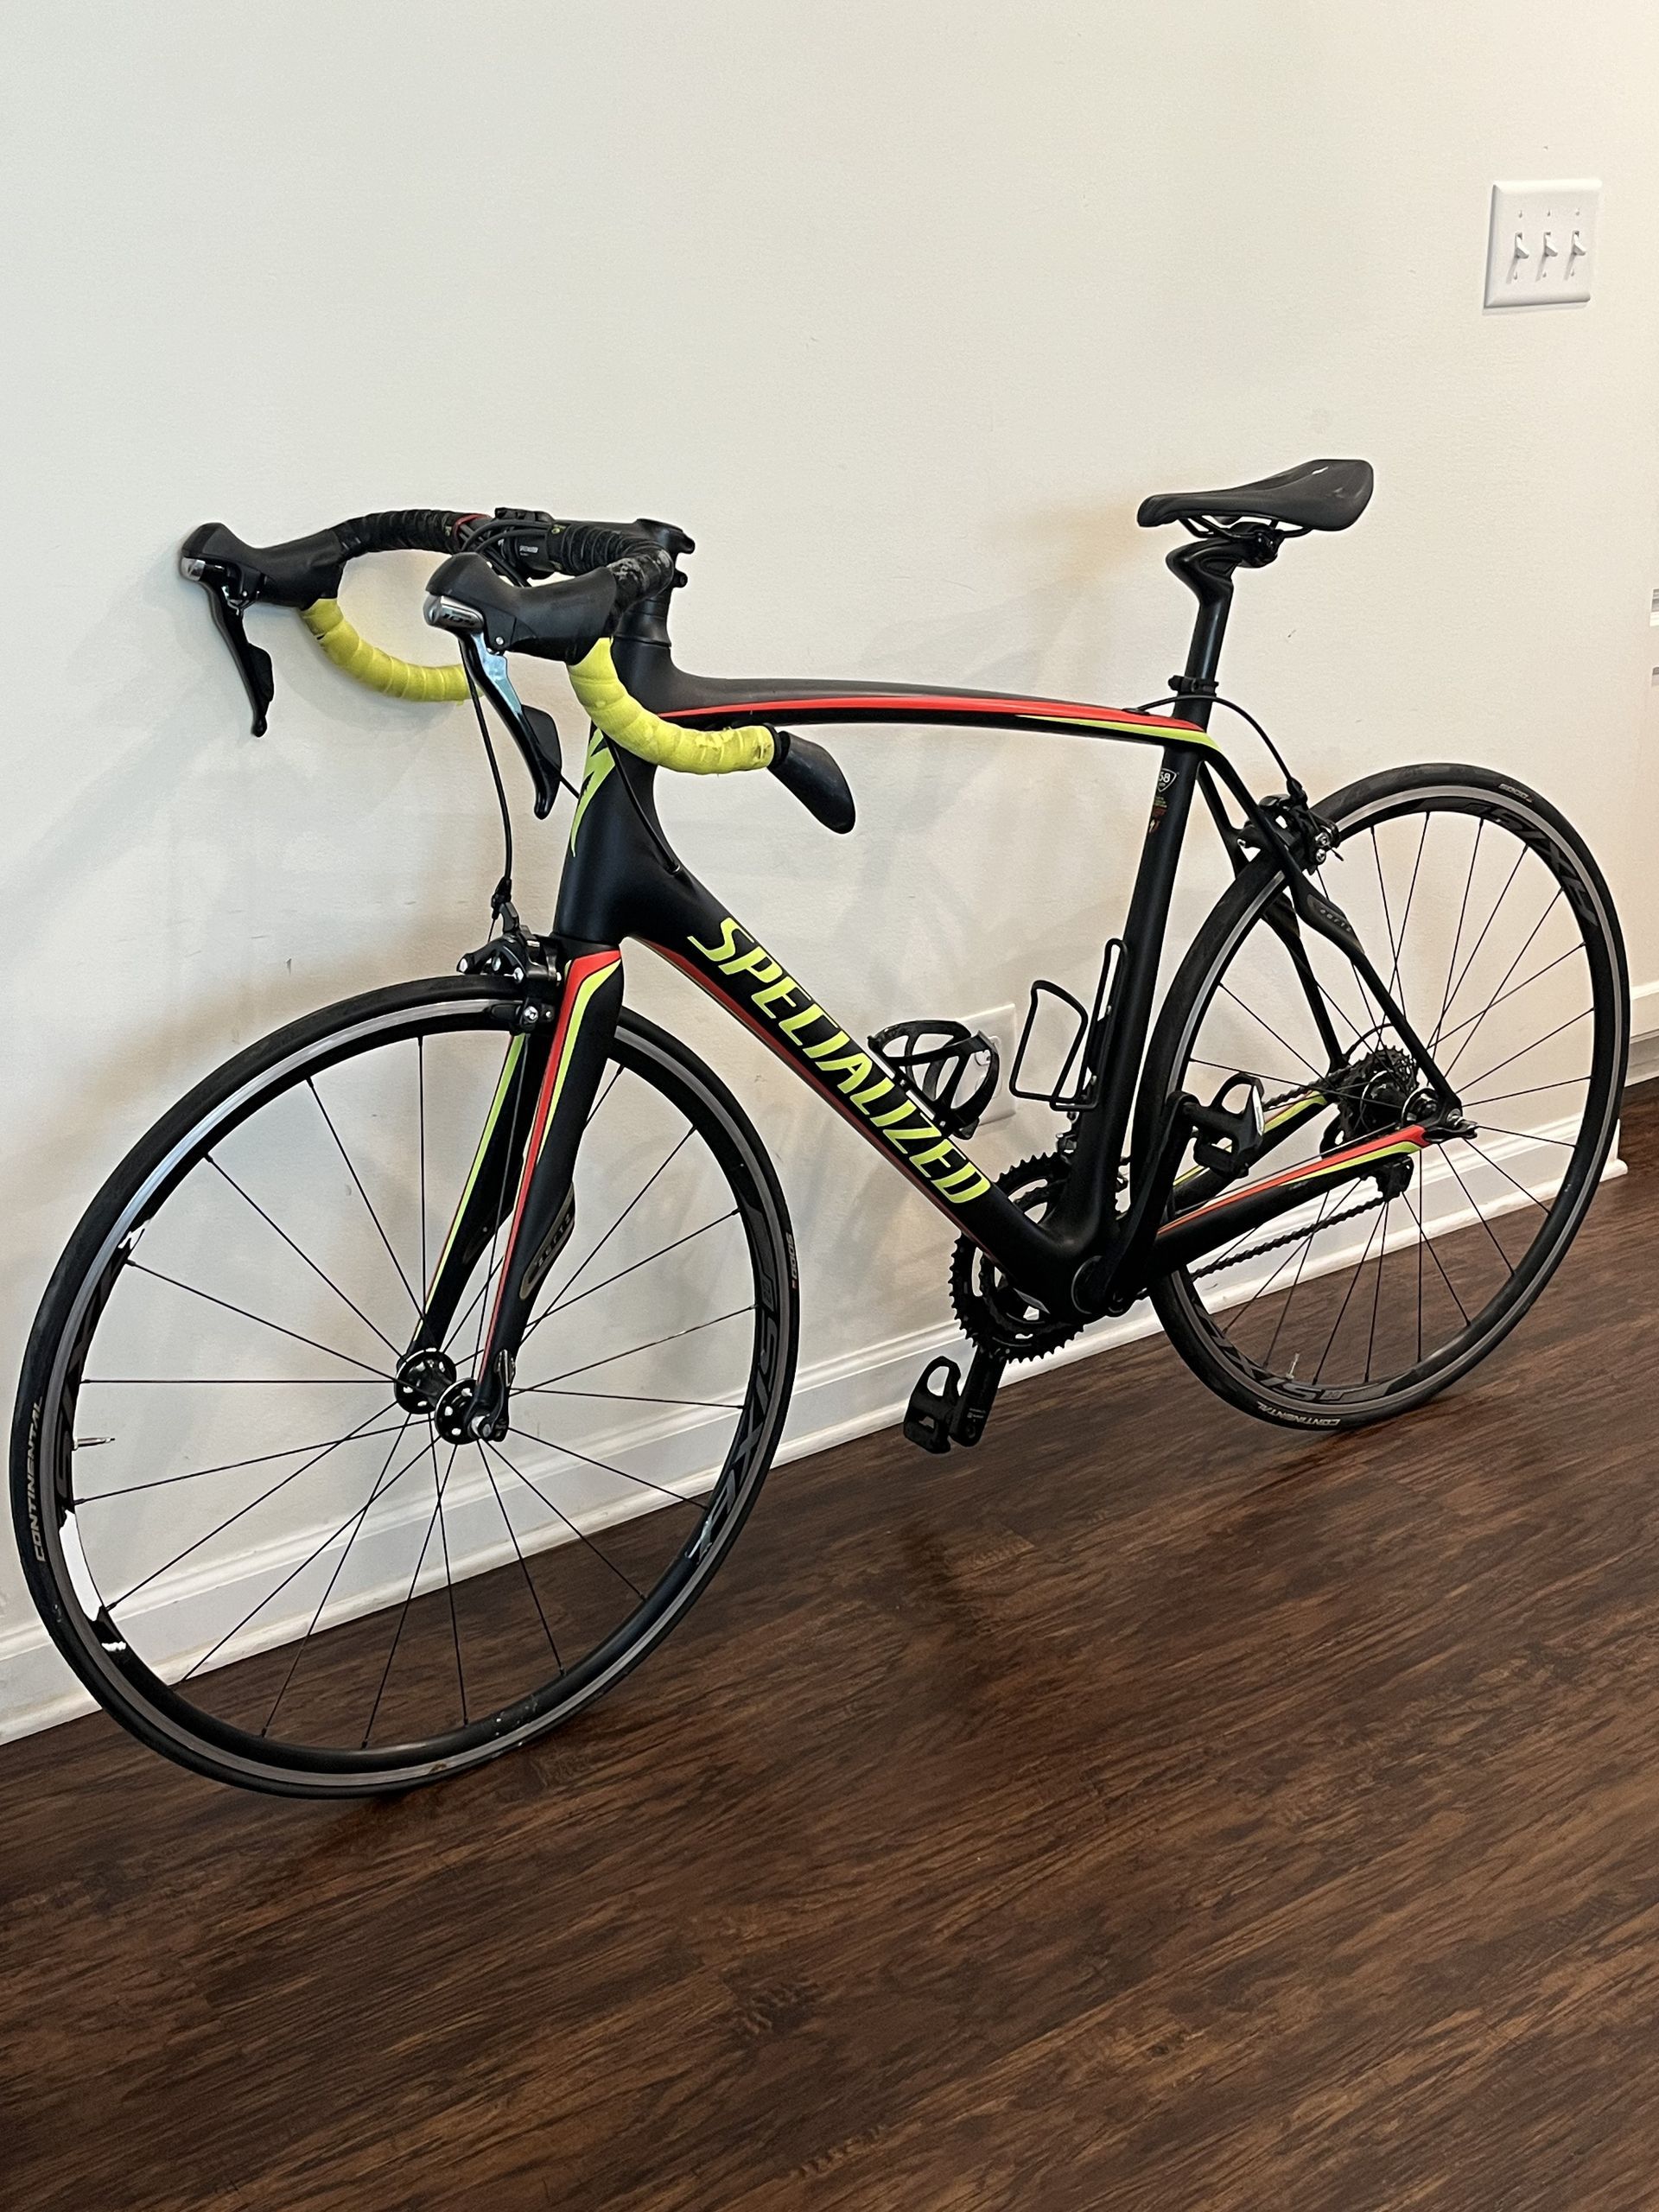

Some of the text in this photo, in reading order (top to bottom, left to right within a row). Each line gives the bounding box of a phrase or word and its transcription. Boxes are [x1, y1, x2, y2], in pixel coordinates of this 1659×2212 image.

[688, 917, 992, 1204] SPECIALIZED
[786, 1232, 798, 1281] 5000
[1257, 1401, 1341, 1426] CONTINENTAL
[27, 1396, 47, 1562] CONTINENTAL
